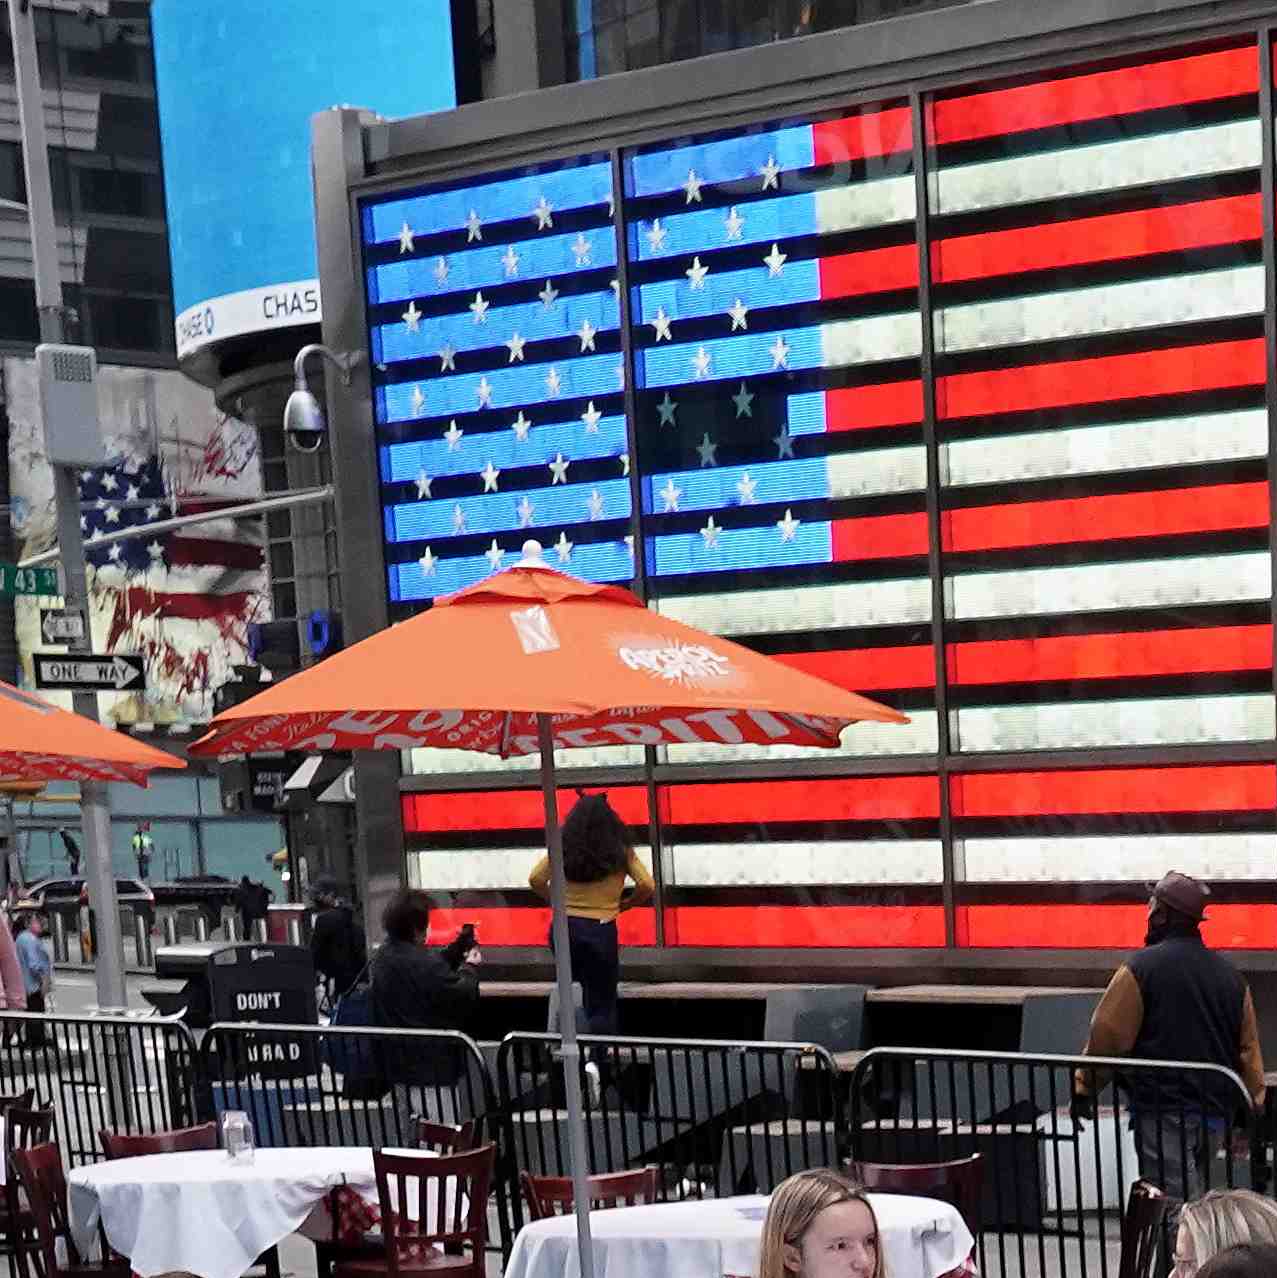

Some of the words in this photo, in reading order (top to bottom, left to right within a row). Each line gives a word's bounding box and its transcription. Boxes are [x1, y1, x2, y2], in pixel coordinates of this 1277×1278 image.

[263, 290, 318, 319] CHAS
[50, 664, 80, 679] ONE
[96, 664, 128, 679] WAY
[236, 992, 281, 1011] DON'T
